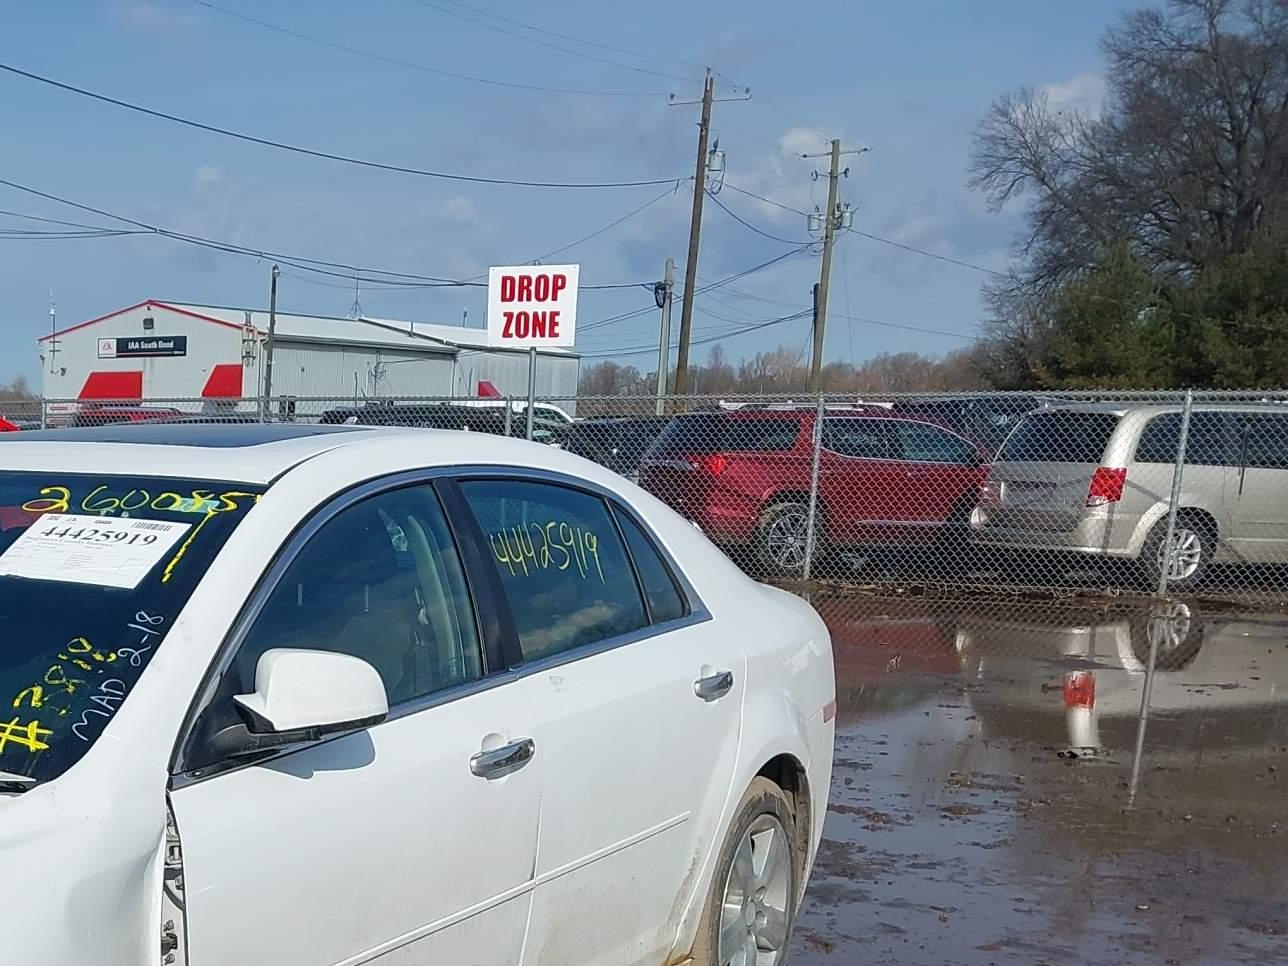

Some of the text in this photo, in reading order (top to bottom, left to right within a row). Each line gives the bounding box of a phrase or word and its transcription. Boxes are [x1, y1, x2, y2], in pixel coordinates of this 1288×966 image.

[500, 273, 567, 303] DROP
[501, 310, 561, 339] ZONE
[127, 341, 140, 350] IAA
[141, 340, 158, 349] South
[40, 524, 159, 547] 44425919
[489, 520, 606, 584] 44425919
